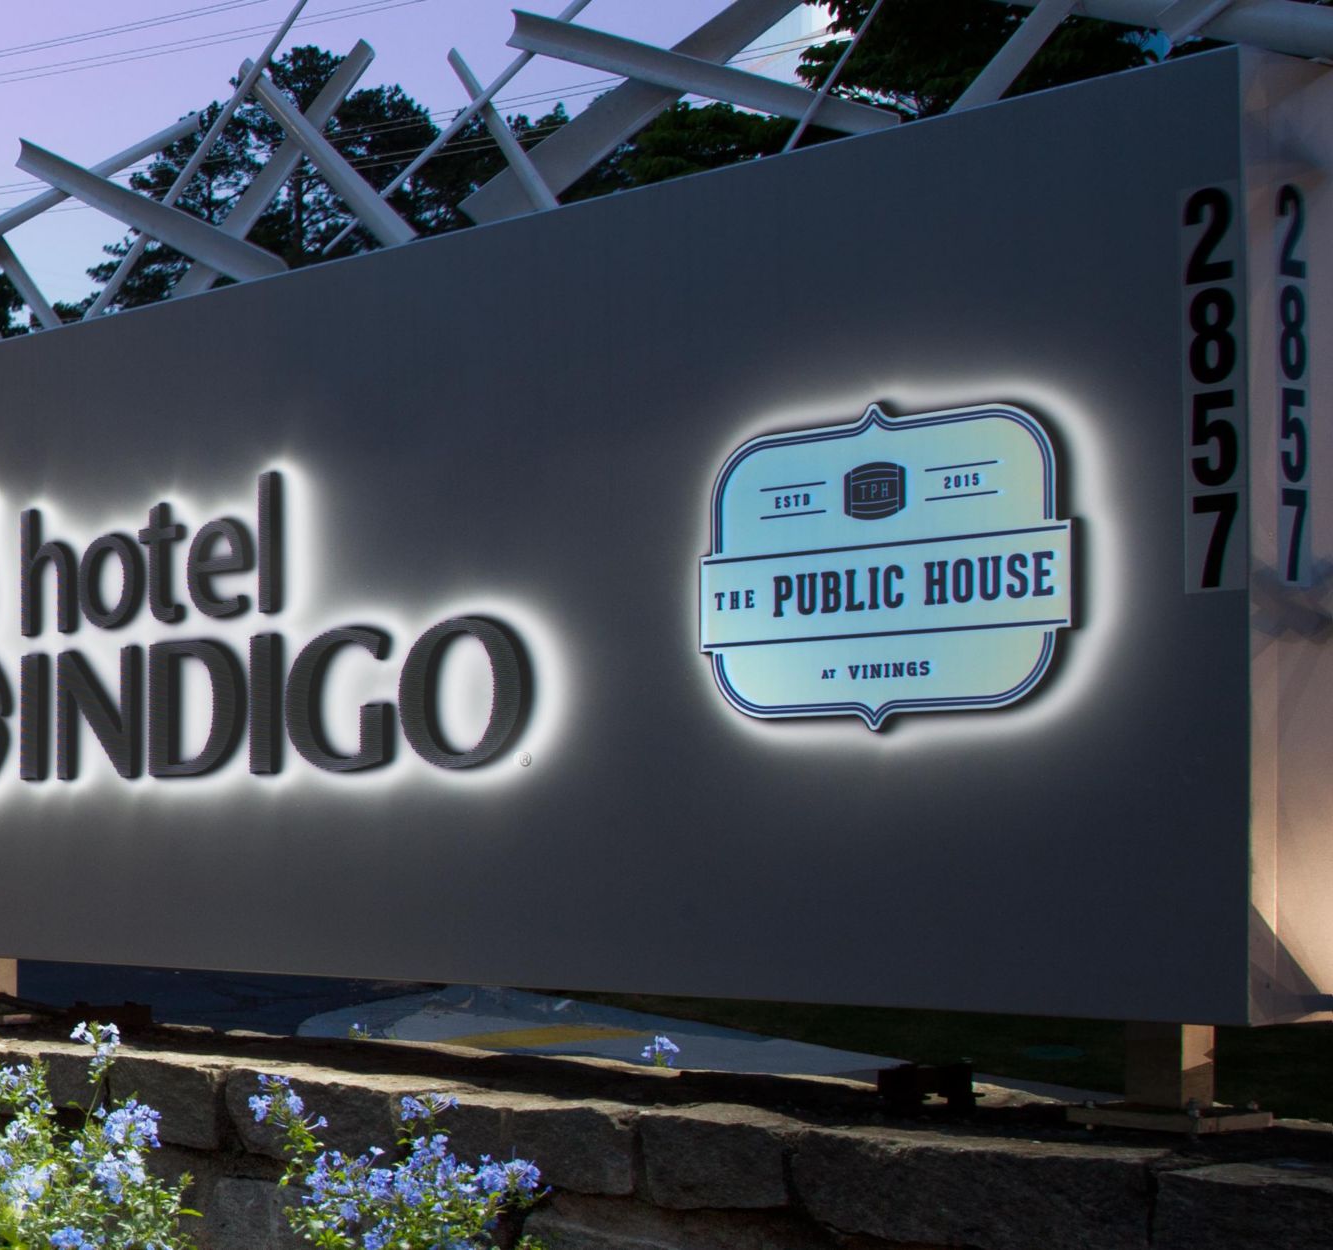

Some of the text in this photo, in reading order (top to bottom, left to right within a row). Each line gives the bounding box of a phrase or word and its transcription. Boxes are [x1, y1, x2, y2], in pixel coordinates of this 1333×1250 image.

[1182, 186, 1238, 589] 2857
[1275, 183, 1308, 582] 2857
[774, 493, 811, 509] ESTD
[860, 482, 889, 500] TPH
[944, 472, 980, 489] 2015
[20, 469, 283, 637] hotel
[714, 551, 1055, 618] THE PUBLIC HOUSE
[20, 614, 534, 782] INDIGO
[821, 660, 930, 680] AT VININGS
